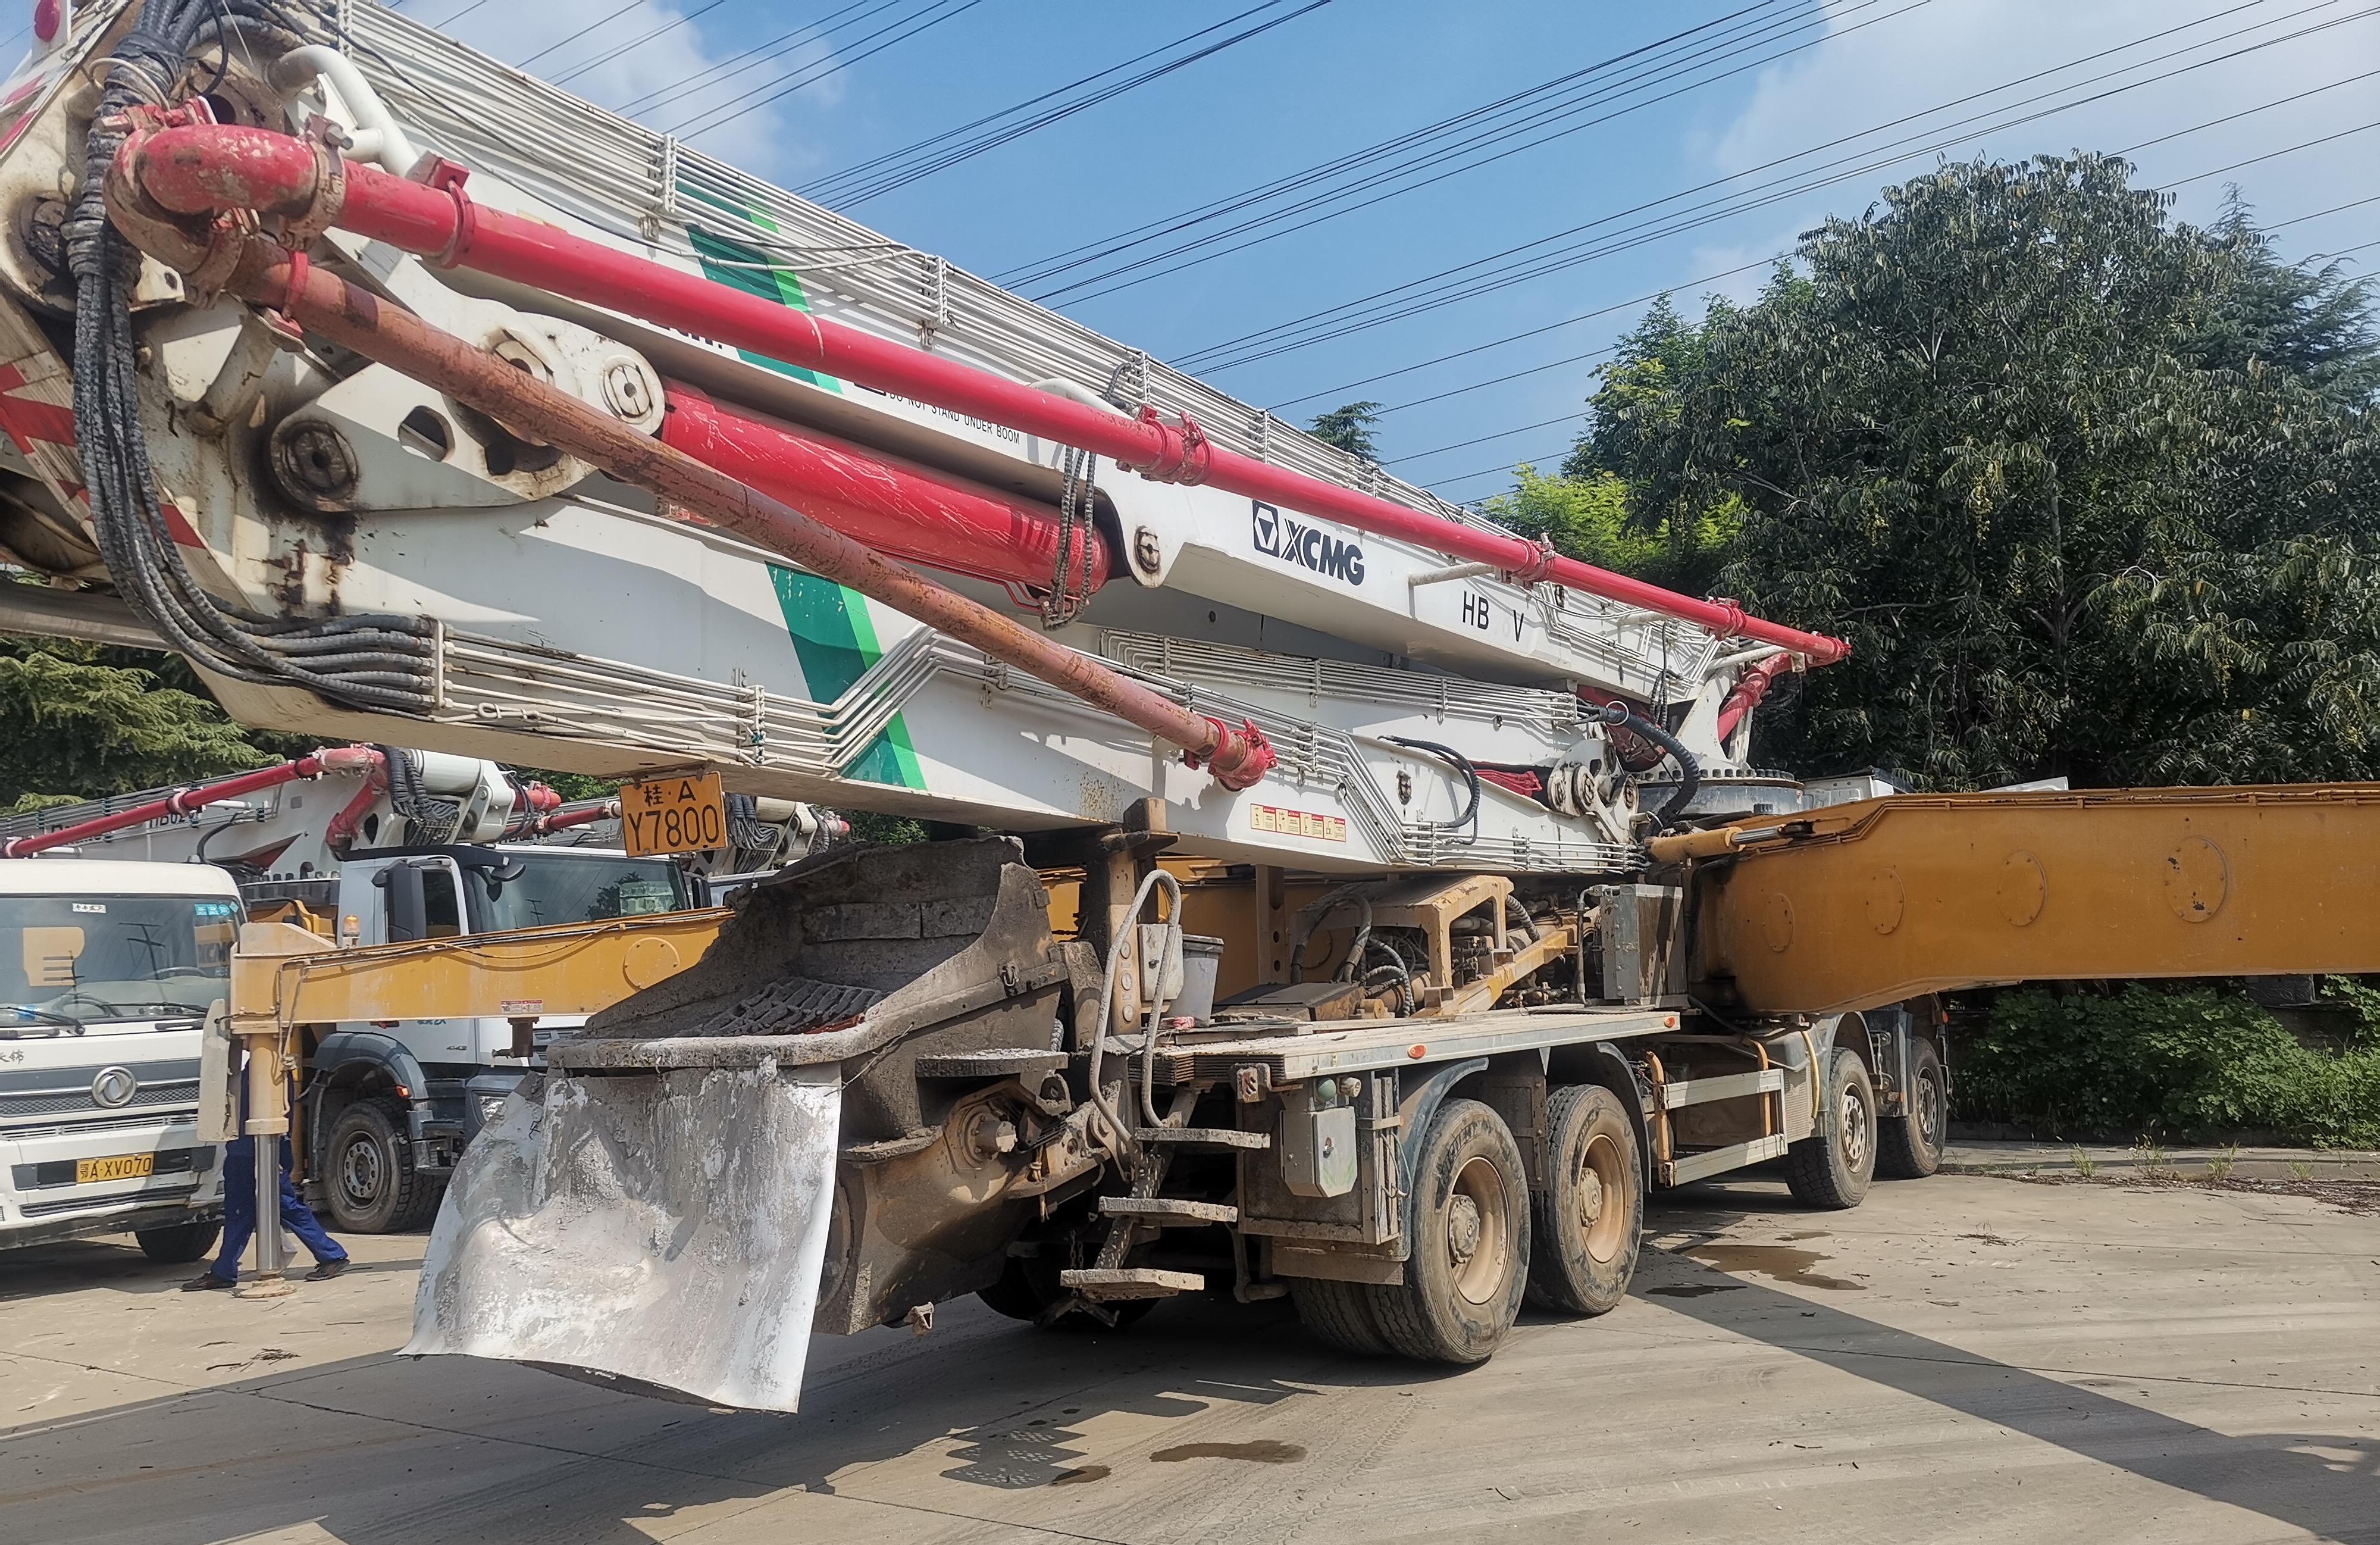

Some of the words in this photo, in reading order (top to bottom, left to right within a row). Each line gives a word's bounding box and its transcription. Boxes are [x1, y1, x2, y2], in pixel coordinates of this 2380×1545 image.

[931, 406, 960, 422] STAND
[964, 414, 992, 434] UNDER
[997, 425, 1019, 445] BOOM
[1280, 518, 1365, 586] XCMG
[1463, 590, 1489, 630] HB
[1513, 609, 1524, 642] V
[627, 804, 719, 852] Y7800
